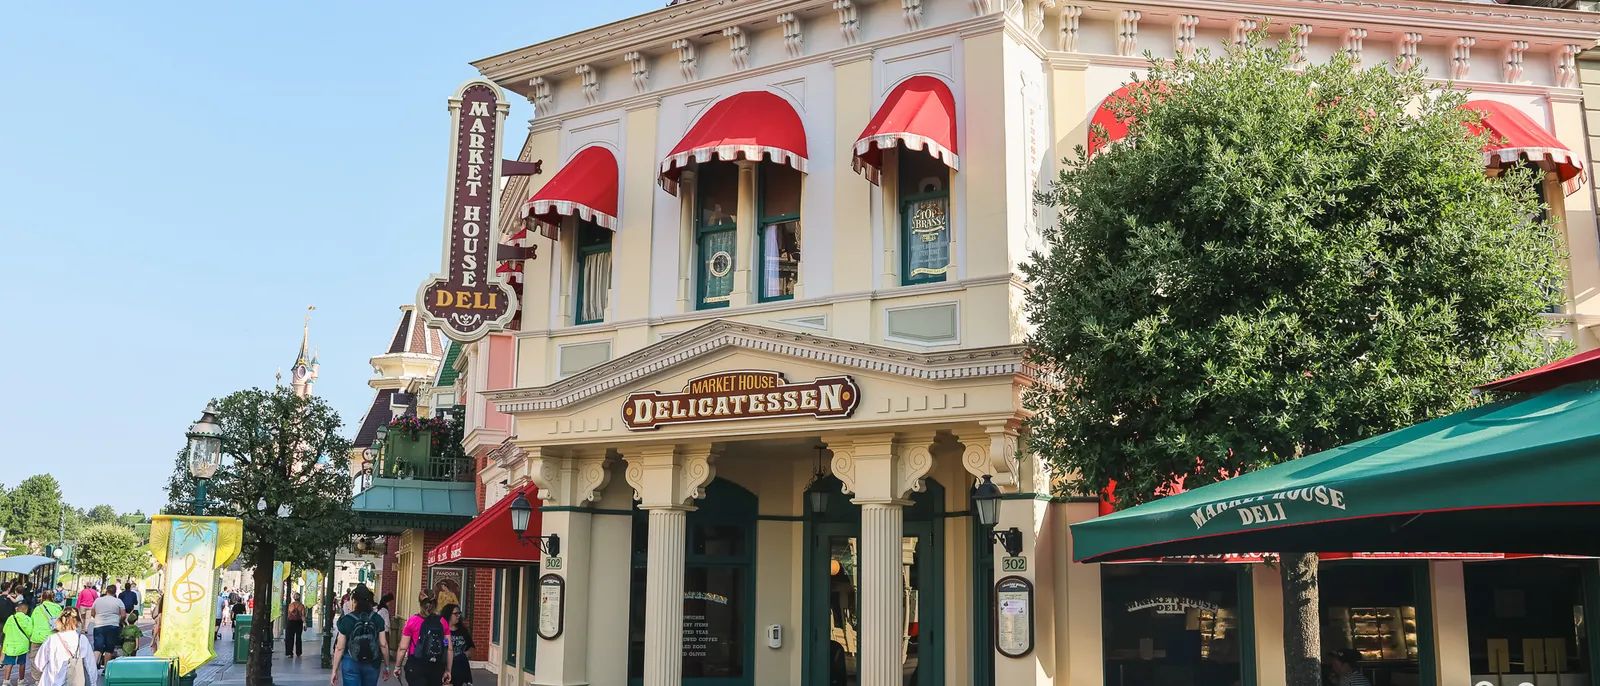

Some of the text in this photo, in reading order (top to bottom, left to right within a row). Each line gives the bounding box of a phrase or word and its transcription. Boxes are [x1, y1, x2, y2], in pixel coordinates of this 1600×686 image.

[462, 101, 490, 288] MARKET HOUSE
[915, 216, 941, 228] BRASS
[920, 209, 937, 220] TOP
[436, 289, 497, 310] DELI
[692, 374, 775, 394] MARKET HOUSE
[632, 383, 844, 424] DELICATESSEN
[1237, 502, 1287, 526] DELI
[546, 558, 561, 568] 302
[1004, 558, 1025, 570] 302
[1157, 603, 1186, 614] DELI
